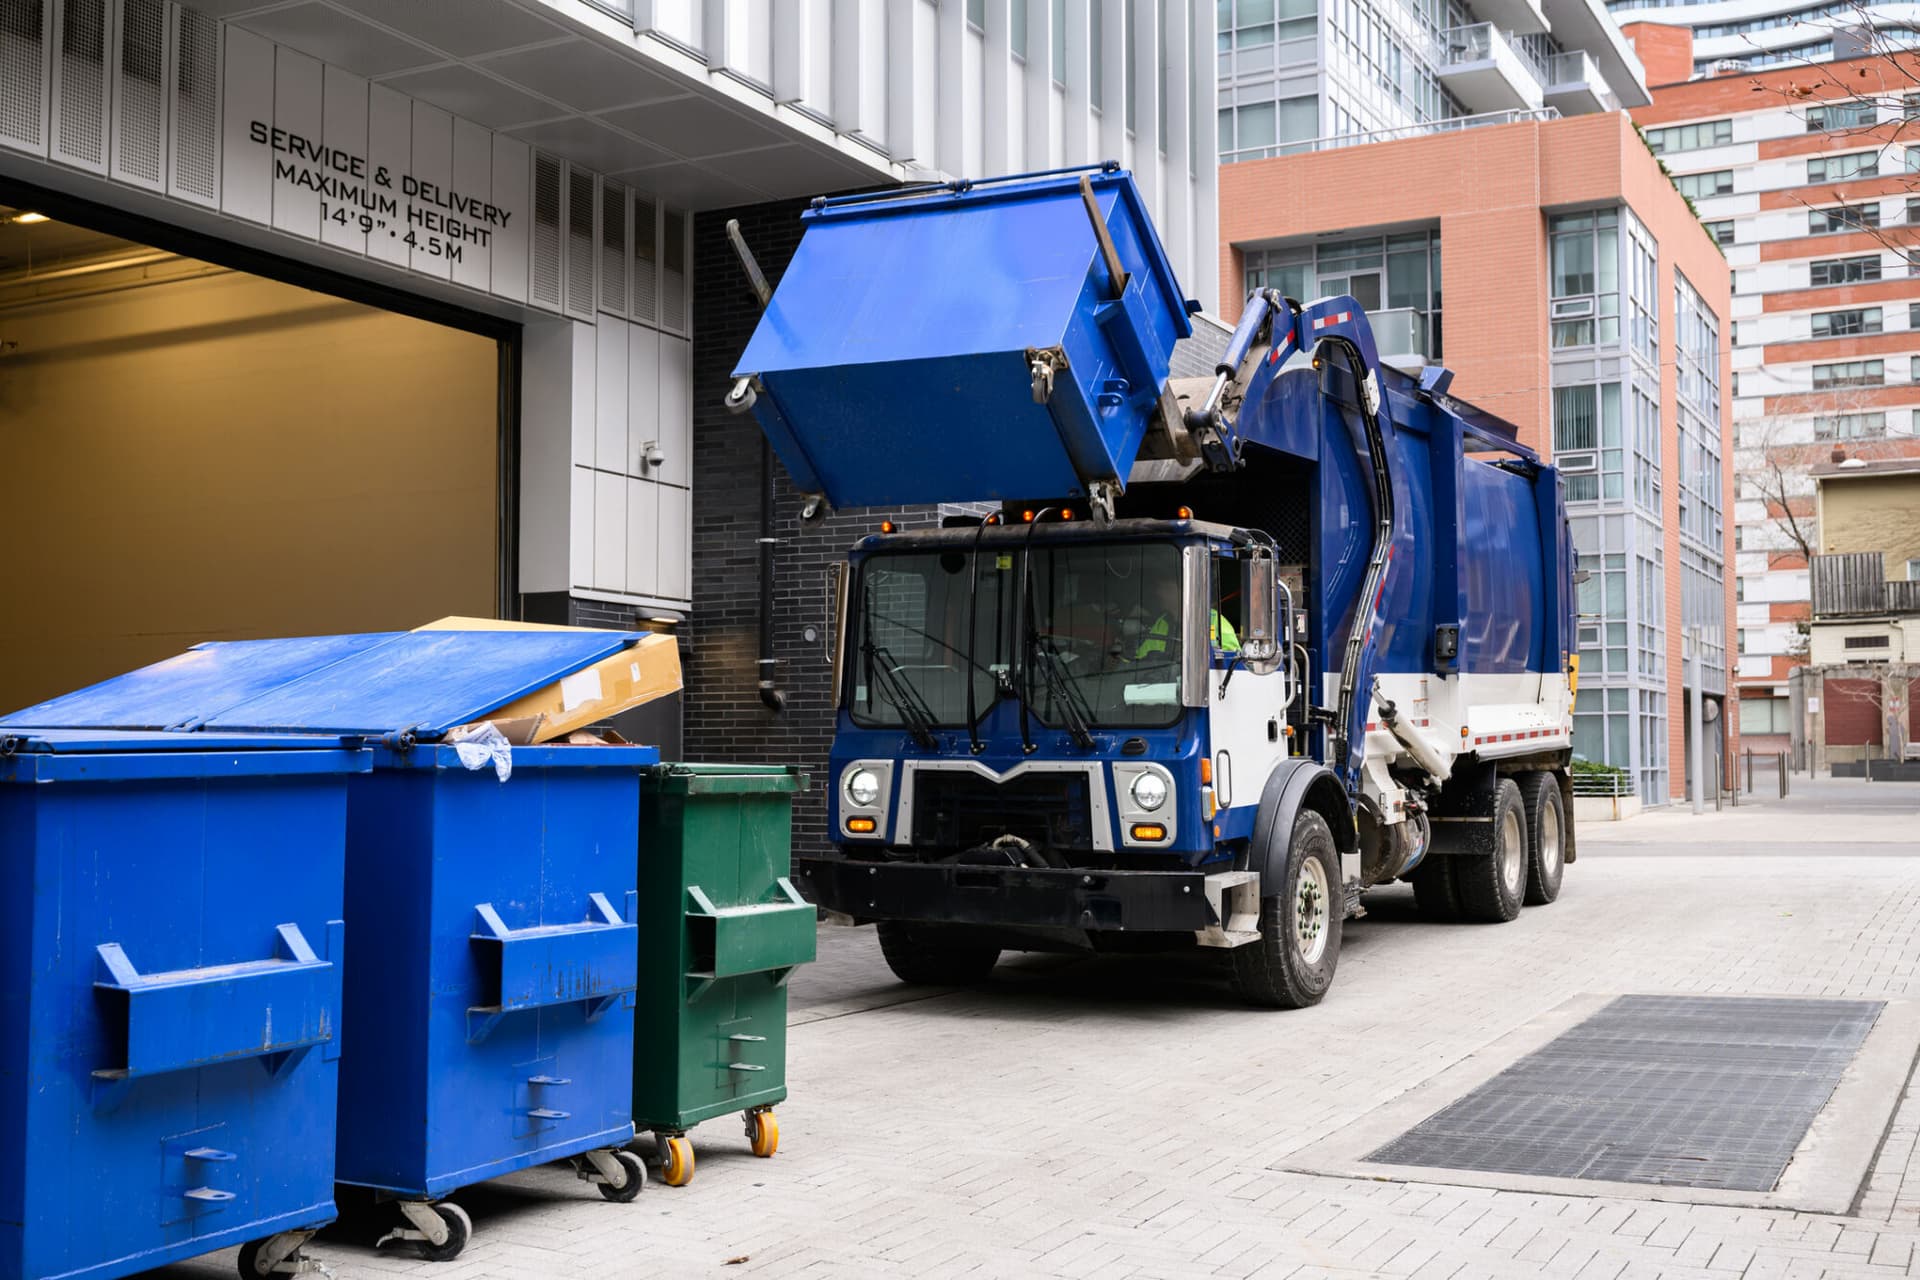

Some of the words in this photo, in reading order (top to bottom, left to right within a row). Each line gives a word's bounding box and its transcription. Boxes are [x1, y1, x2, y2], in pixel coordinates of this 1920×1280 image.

[250, 120, 366, 178] SERVICE
[374, 166, 393, 189] &
[402, 174, 512, 229] DELIVERY
[275, 159, 397, 218] MAXIMUM
[407, 204, 492, 247] HEIGHT
[402, 230, 463, 263] 4.5M
